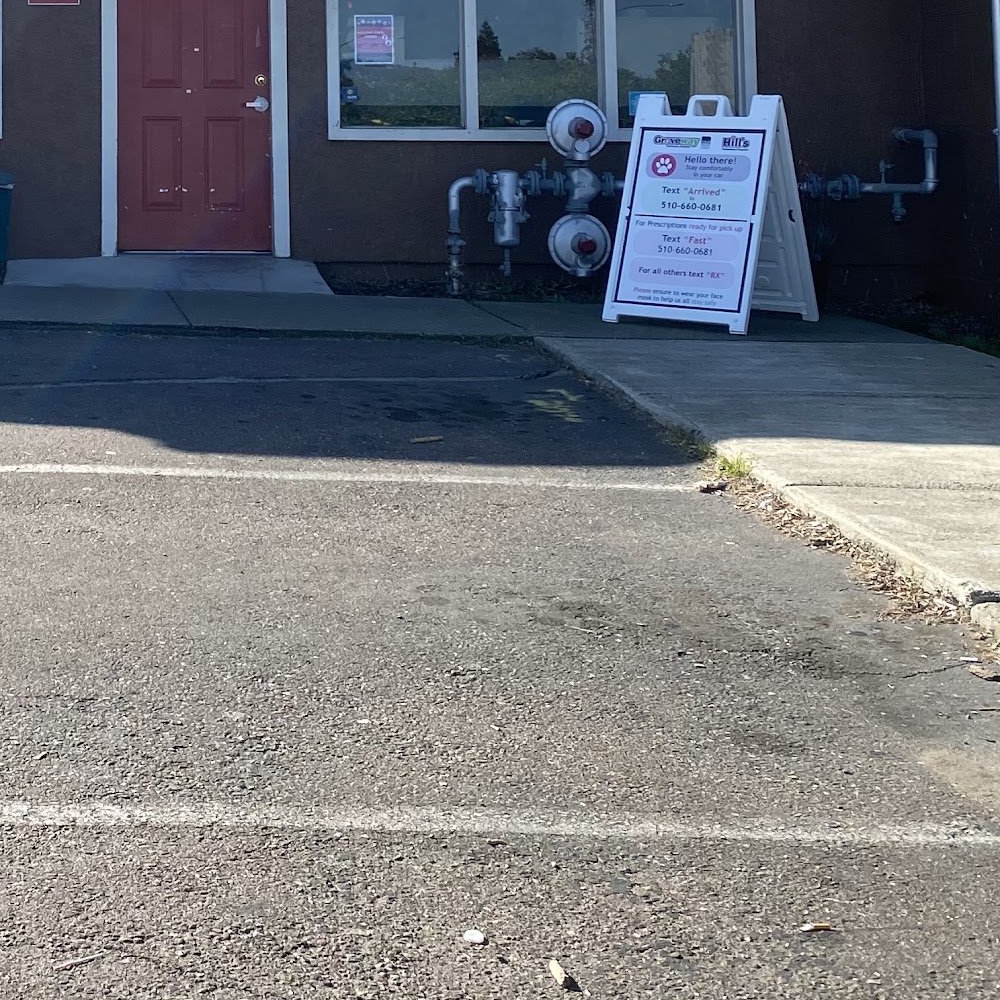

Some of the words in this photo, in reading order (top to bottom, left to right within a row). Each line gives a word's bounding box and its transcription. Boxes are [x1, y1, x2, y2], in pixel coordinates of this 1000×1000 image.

[723, 136, 750, 148] Hill's
[685, 156, 707, 164] Hello
[710, 157, 736, 165] there!
[662, 186, 680, 194] Text
[661, 201, 721, 211] 510-660-0681
[662, 235, 680, 243] Text
[658, 245, 713, 255] 510-660-0681
